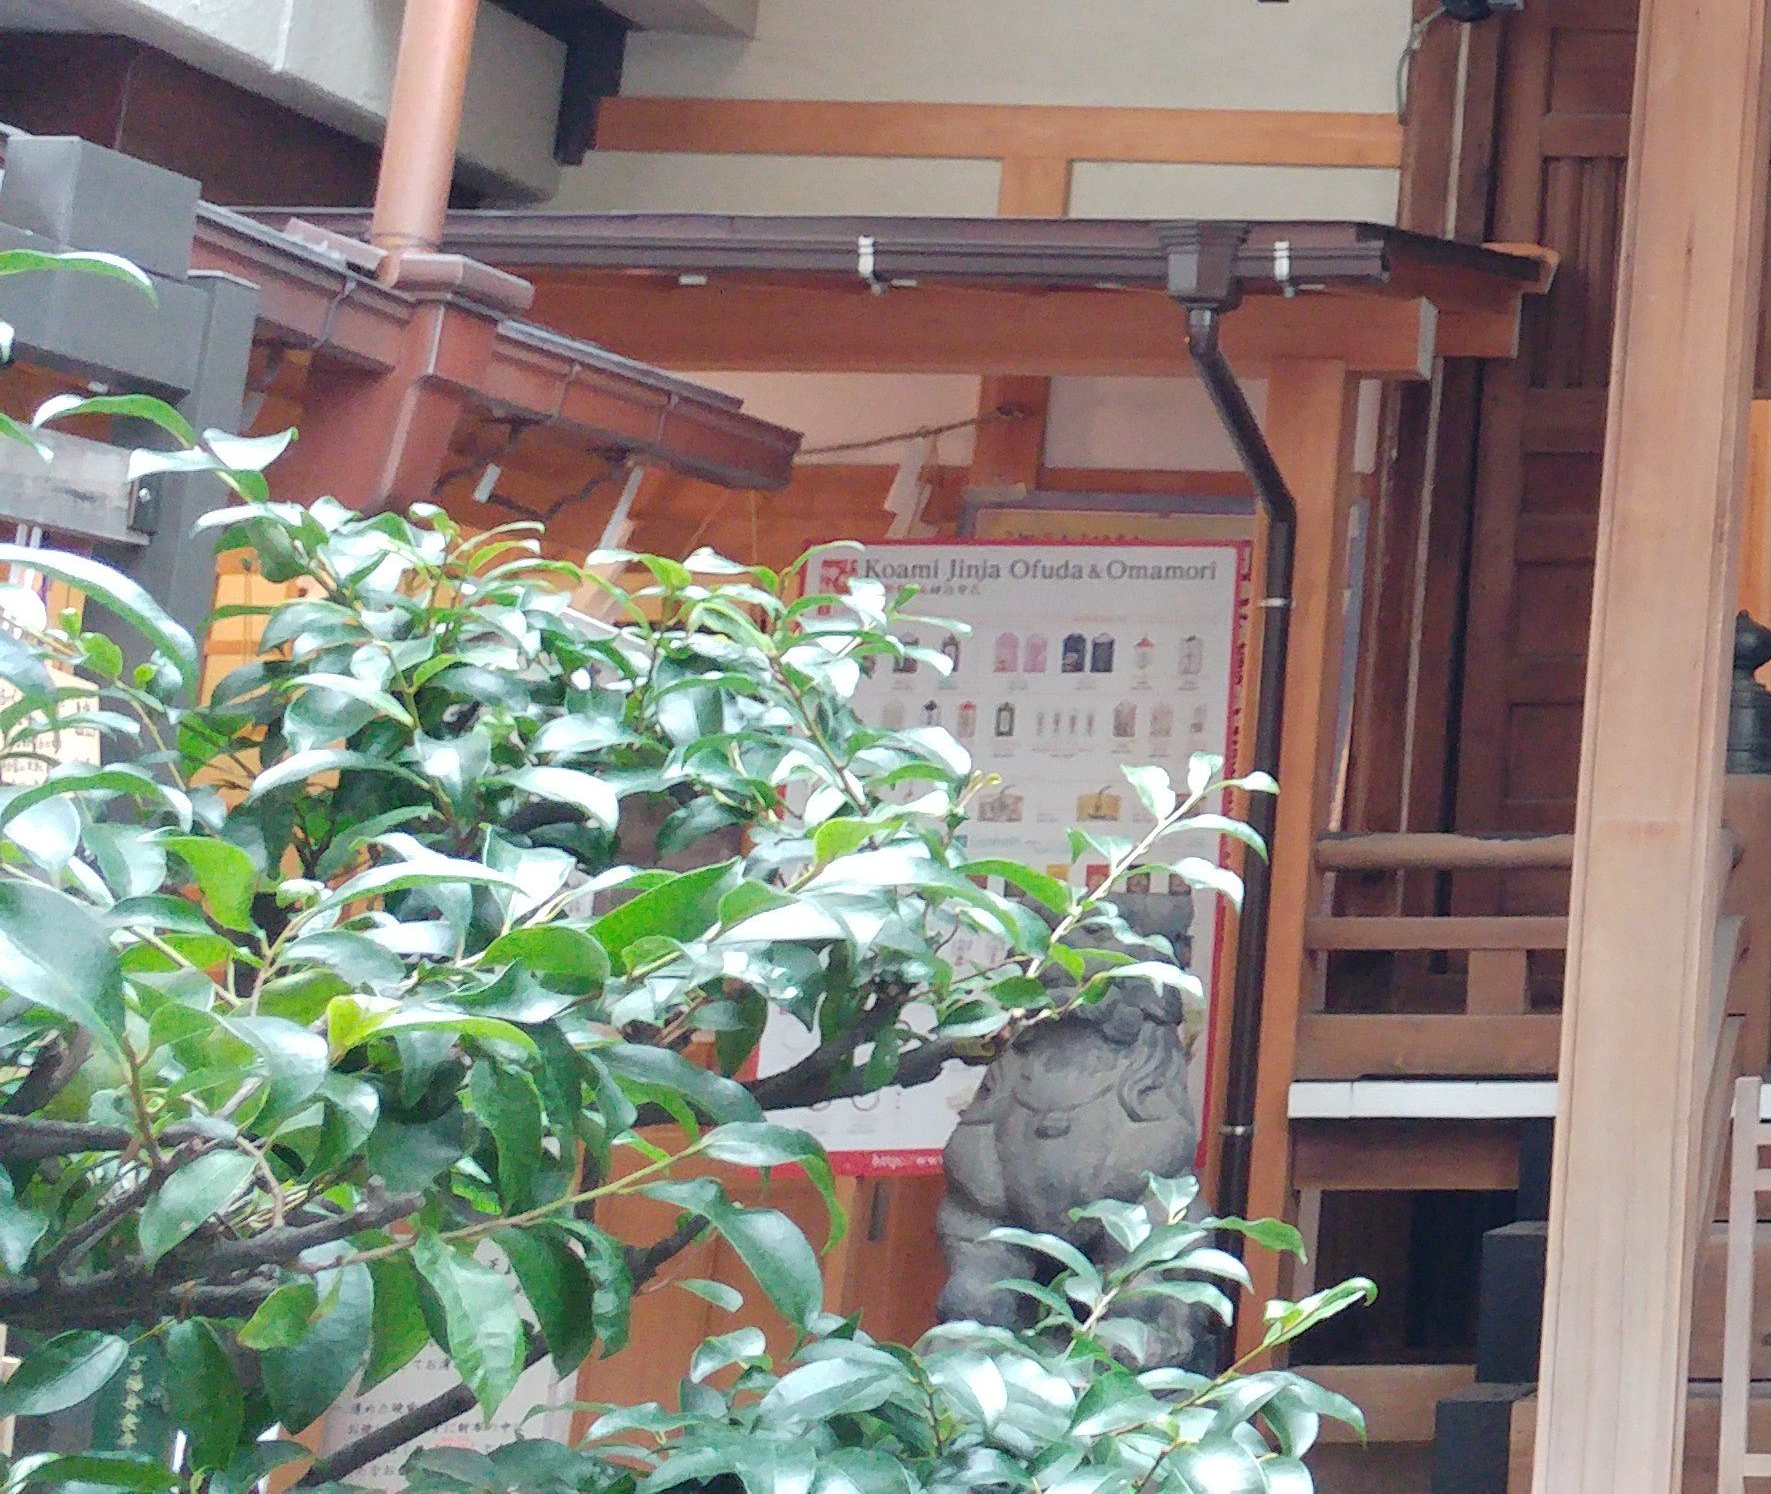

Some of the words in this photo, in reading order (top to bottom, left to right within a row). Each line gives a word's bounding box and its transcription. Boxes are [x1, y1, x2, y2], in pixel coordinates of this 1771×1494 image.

[865, 558, 938, 581] Koami
[947, 557, 1000, 583] Jinja
[1009, 557, 1085, 581] Ofuda
[1089, 562, 1103, 580] &
[1106, 560, 1217, 581] Omamori
